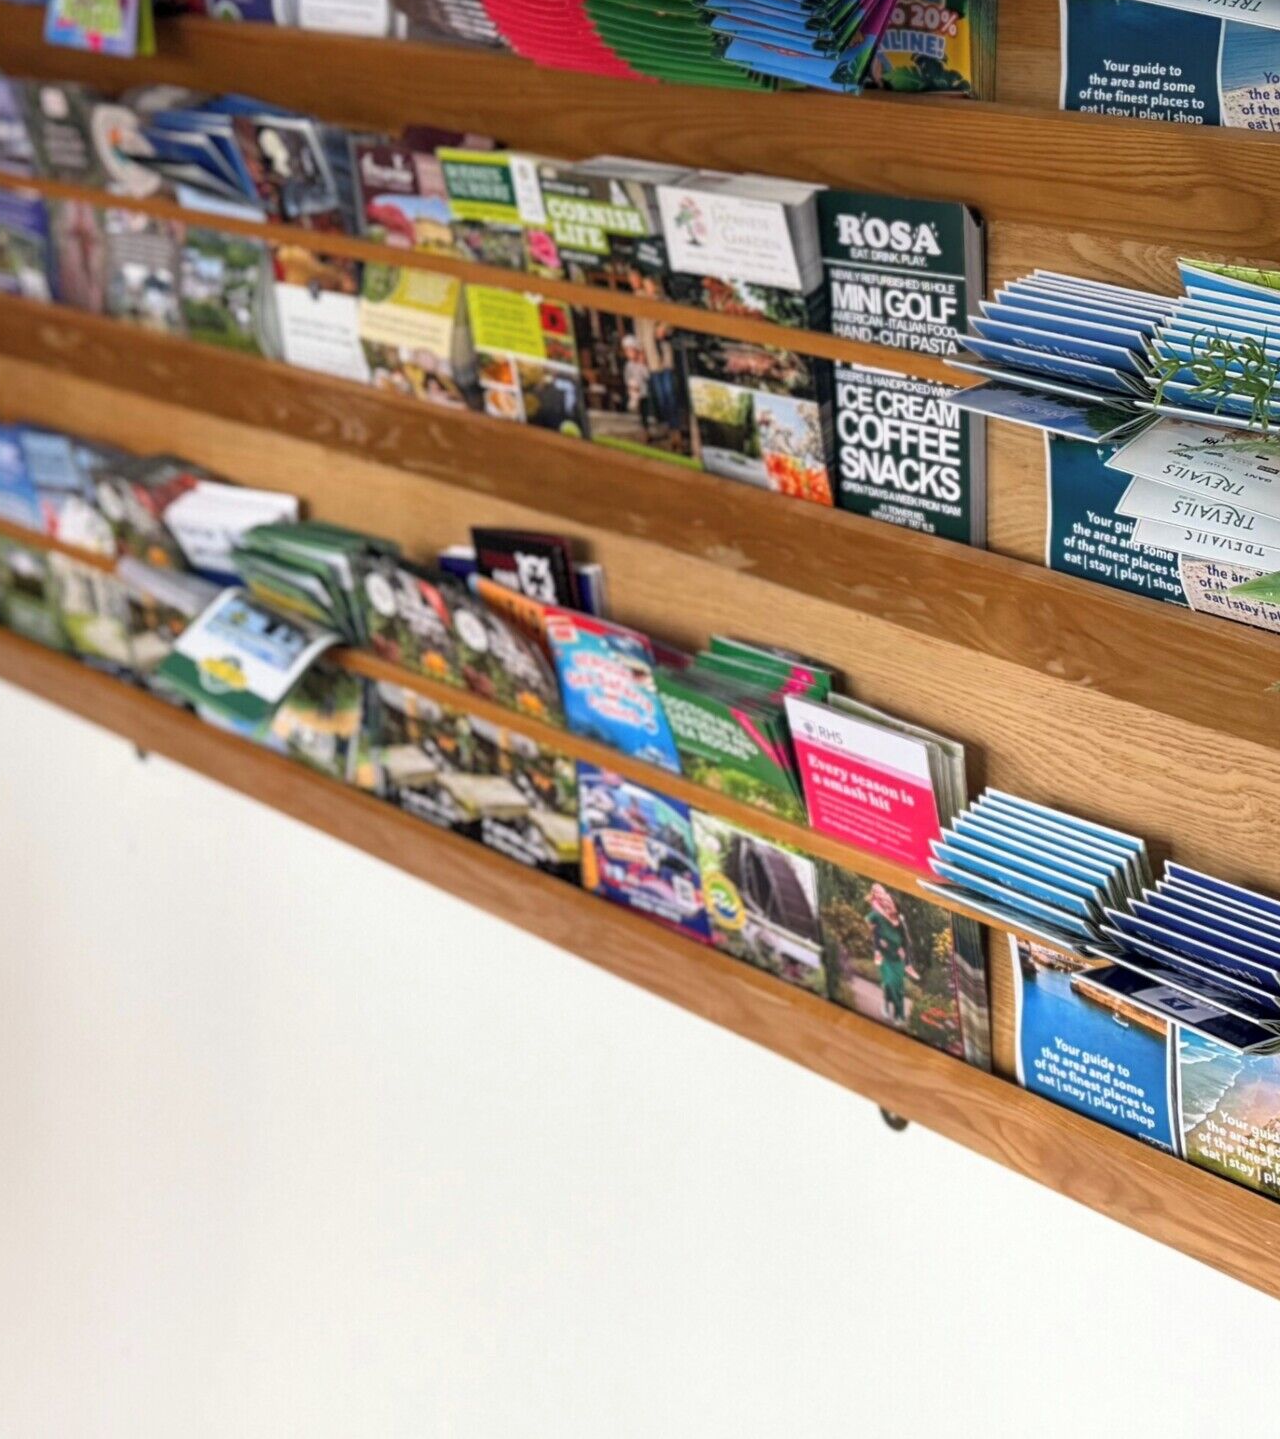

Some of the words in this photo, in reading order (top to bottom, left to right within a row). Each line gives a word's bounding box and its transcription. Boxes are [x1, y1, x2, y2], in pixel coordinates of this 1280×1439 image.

[910, 5, 957, 37] 20%
[1102, 59, 1131, 73] Your
[1132, 62, 1166, 76] guide
[1169, 64, 1182, 77] to
[1089, 73, 1107, 86] the
[1110, 77, 1136, 88] area
[1138, 75, 1161, 90] and
[1164, 80, 1196, 93] some
[1248, 88, 1271, 100] the
[1079, 88, 1092, 100] of
[1094, 88, 1113, 102] the
[1115, 90, 1149, 106] finest
[1151, 93, 1189, 109] places
[1191, 97, 1205, 110] to
[1241, 103, 1256, 116] of
[1260, 103, 1280, 116] the
[1173, 109, 1203, 125] shop
[1248, 120, 1269, 131] eat
[837, 214, 942, 256] ROSA
[861, 274, 919, 289] REFURBISHED
[931, 282, 955, 295] HOLE
[831, 281, 882, 315] MINI
[884, 289, 957, 324] GOLF
[927, 324, 958, 339] FOOD
[910, 337, 958, 355] PASTA
[873, 377, 930, 395] HANDPICKED
[836, 383, 873, 413] ICE
[875, 390, 960, 429] CREAM
[837, 410, 961, 466] COFFEE
[839, 445, 961, 502] SNACKS
[1163, 463, 1245, 496] TREVAILS
[895, 491, 920, 506] WEEK
[920, 497, 940, 511] FROM
[940, 502, 961, 517] 10AM
[1172, 500, 1255, 530] TREVAILS
[1087, 510, 1112, 528] Your
[1063, 536, 1076, 549] of
[1078, 539, 1096, 554] the
[1097, 543, 1129, 563] finest
[1131, 552, 1168, 574] places
[1073, 522, 1092, 538] the
[1093, 530, 1117, 545] area
[1143, 544, 1174, 561] some
[1064, 551, 1082, 566] eat
[1089, 558, 1112, 577] stay
[1120, 566, 1145, 588] play
[1153, 575, 1183, 596] shop
[1199, 576, 1213, 589] of
[1207, 564, 1228, 579] the
[1204, 591, 1223, 605] eat
[1233, 598, 1259, 616] stay
[818, 725, 843, 745] RHS
[807, 753, 849, 782] Every
[850, 771, 899, 801] season
[901, 789, 915, 806] is
[823, 777, 867, 803] smash
[869, 791, 891, 812] hit
[1054, 1036, 1081, 1058] Your
[1082, 1049, 1116, 1072] guide
[1118, 1064, 1130, 1078] to
[1042, 1047, 1061, 1063] the
[1062, 1055, 1087, 1074] area
[1089, 1065, 1111, 1083] and
[1113, 1076, 1145, 1098] some
[1034, 1059, 1047, 1074] of
[1048, 1063, 1067, 1080] the
[1069, 1071, 1100, 1093] finest
[1103, 1085, 1144, 1113] places
[1145, 1101, 1155, 1115] to
[1037, 1072, 1055, 1087] eat
[1063, 1081, 1086, 1102] stay
[1093, 1095, 1118, 1118] play
[1126, 1107, 1156, 1130] shop
